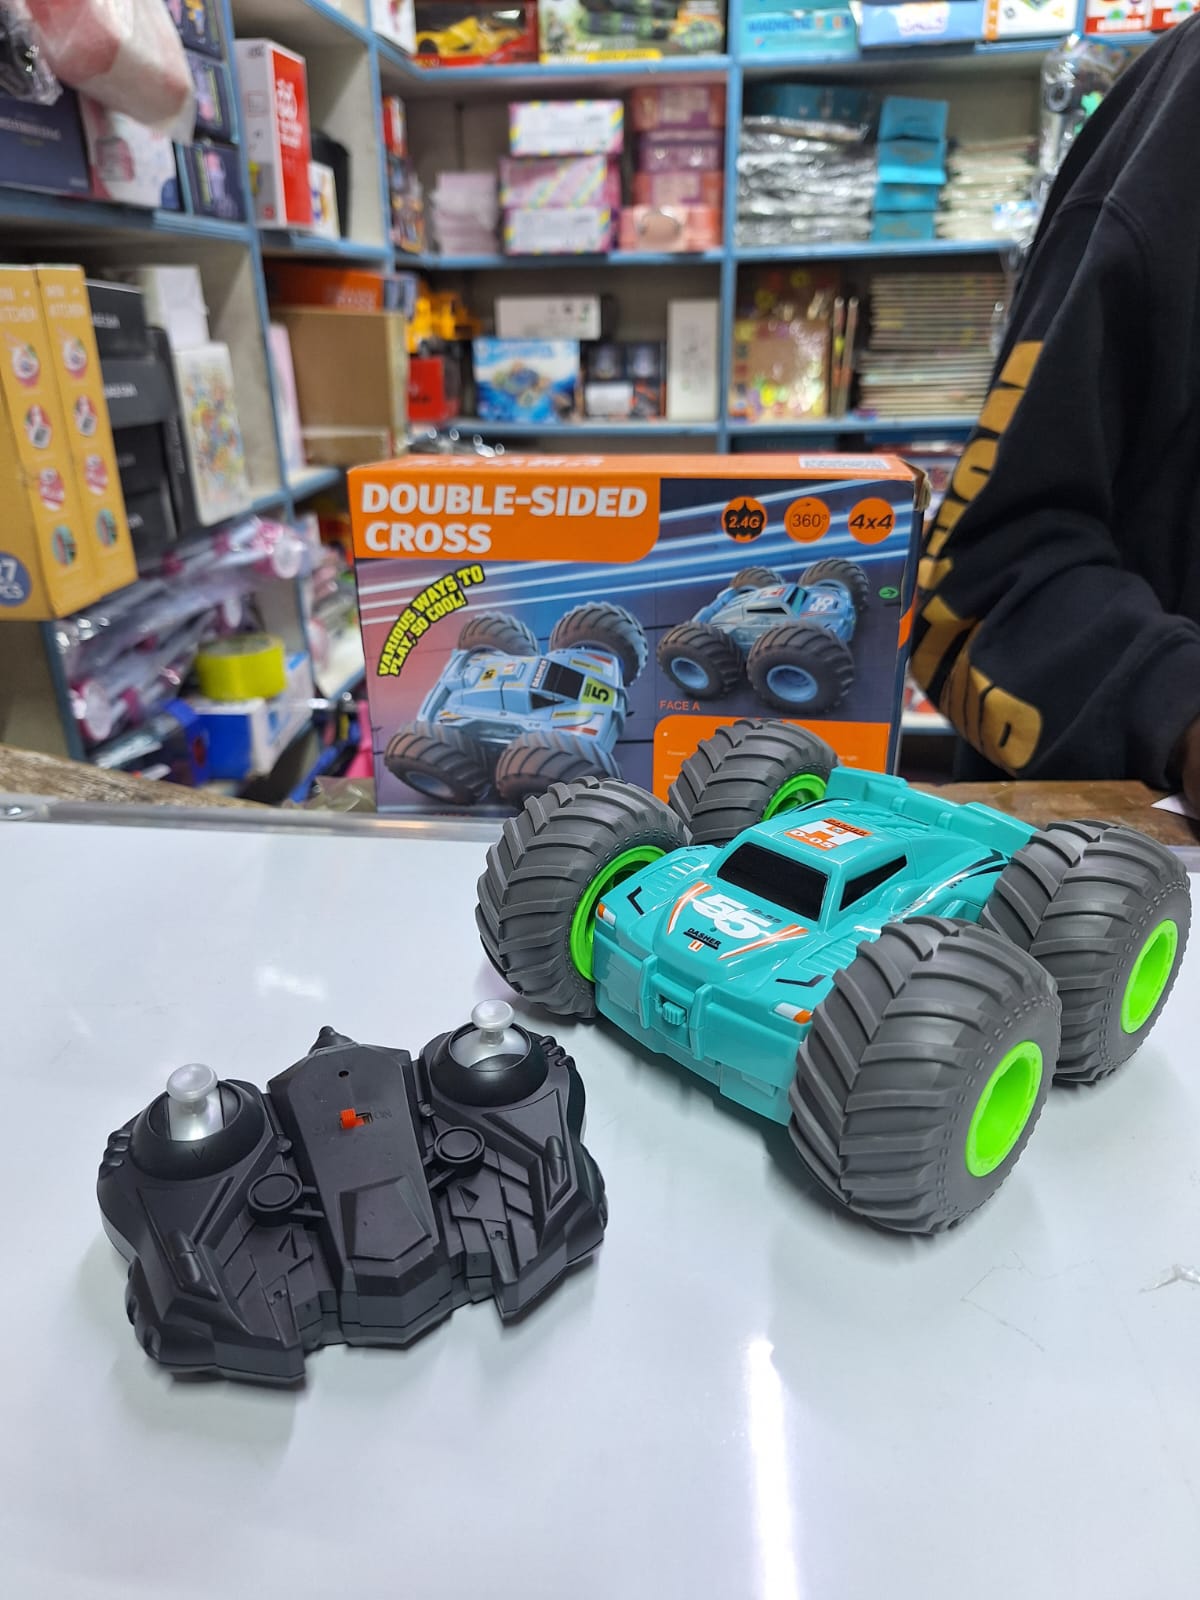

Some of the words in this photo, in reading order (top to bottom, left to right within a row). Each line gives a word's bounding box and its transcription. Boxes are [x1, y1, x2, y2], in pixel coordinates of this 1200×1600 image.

[361, 483, 648, 518] DOUBLE-SIDED
[728, 516, 761, 529] 2.4G
[849, 513, 893, 530] 4x4
[364, 522, 493, 554] CROSS
[378, 608, 417, 676] VARIOUS
[411, 574, 458, 613] WAYS
[456, 564, 484, 586] TO
[389, 638, 417, 676] PLAY,
[410, 618, 430, 637] SO
[425, 591, 467, 622] COOL!
[591, 686, 610, 702] 5
[659, 700, 690, 711] FACE
[691, 701, 701, 711] A
[691, 893, 774, 939] 55
[686, 927, 723, 948] DASHER
